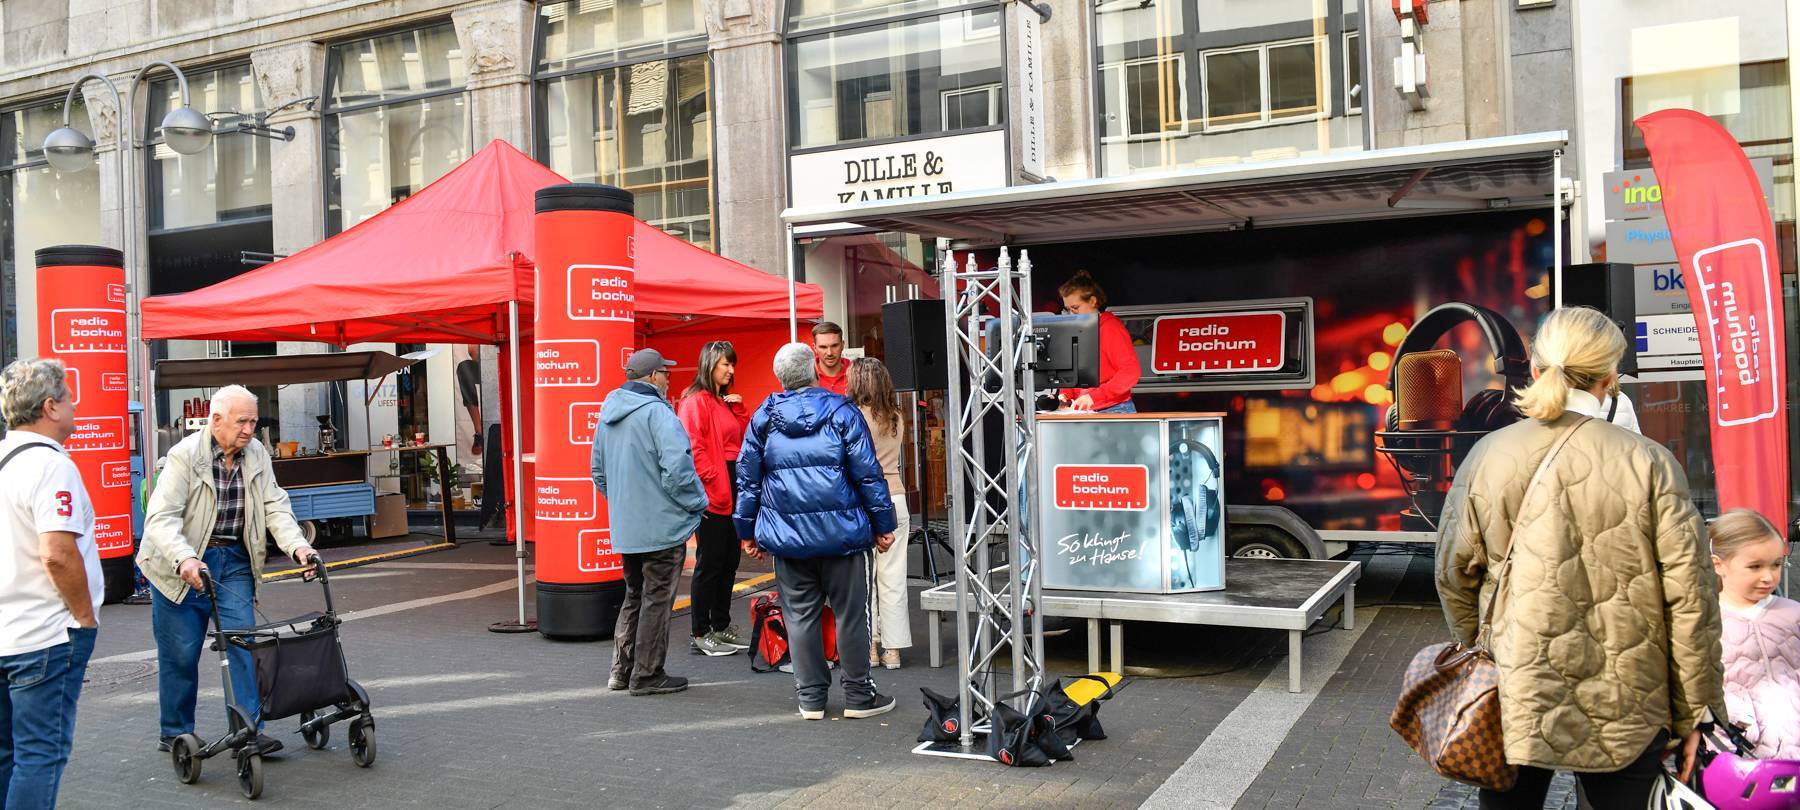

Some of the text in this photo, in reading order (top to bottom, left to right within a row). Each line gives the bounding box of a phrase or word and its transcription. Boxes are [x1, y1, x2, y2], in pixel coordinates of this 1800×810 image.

[1025, 19, 1035, 93] KAMILLE
[844, 151, 944, 185] DILLE &
[1624, 180, 1662, 205] ino
[1626, 228, 1671, 245] Physi
[591, 277, 628, 288] radio
[1653, 268, 1685, 291] bk
[70, 317, 109, 326] radio
[70, 328, 122, 337] bochum
[1179, 324, 1230, 337] radio
[1653, 326, 1698, 335] SCHNEIDE
[1178, 339, 1257, 352] bochum
[536, 349, 560, 358] radio
[536, 361, 580, 370] bochum
[1670, 358, 1703, 366] Hauptein
[75, 423, 100, 431] adio
[1072, 473, 1109, 482] radio
[537, 486, 560, 494] radio
[1072, 484, 1129, 494] bochum
[55, 491, 72, 517] 3
[537, 496, 577, 505] bochum
[94, 522, 111, 530] dio
[96, 531, 123, 539] chum
[1057, 530, 1131, 556] So klingt
[1069, 540, 1148, 567] zu Hause!
